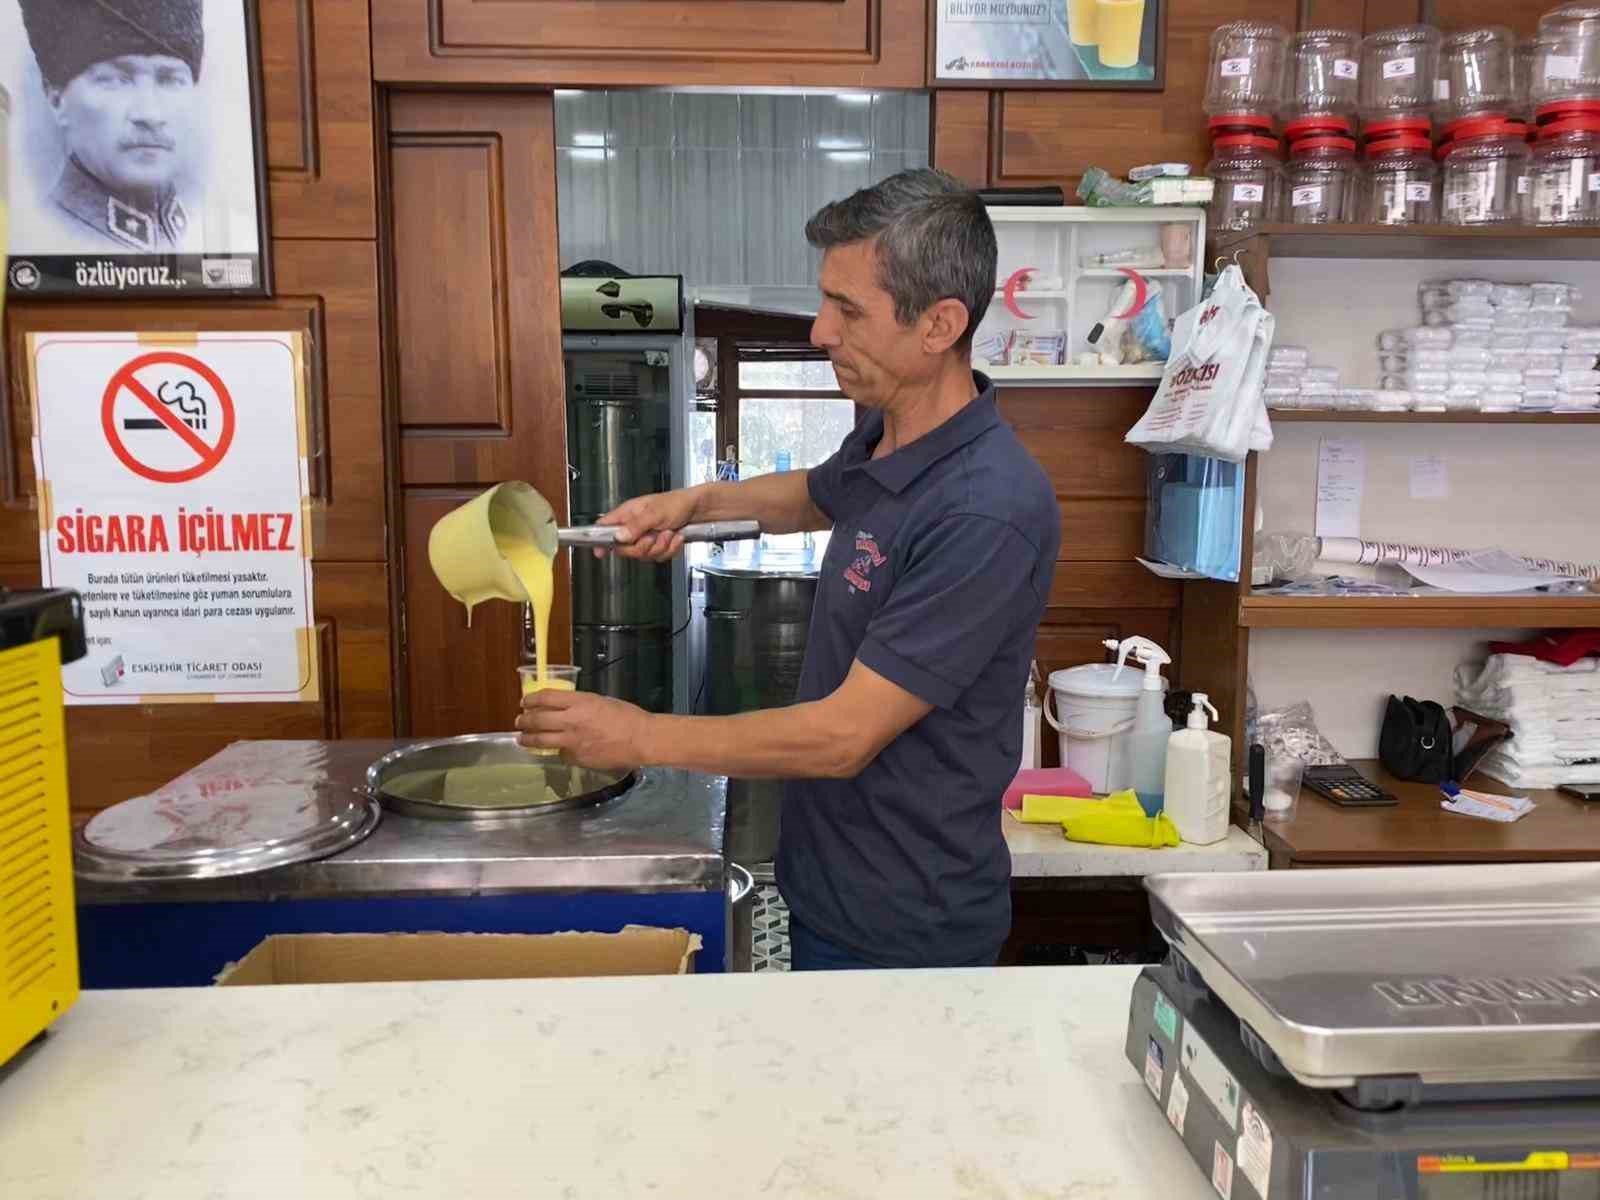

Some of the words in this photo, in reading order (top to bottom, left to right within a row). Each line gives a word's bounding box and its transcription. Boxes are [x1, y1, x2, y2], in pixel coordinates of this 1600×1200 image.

[75, 261, 187, 290] özlüyoruz...
[57, 508, 169, 554] SİGARA
[178, 506, 295, 558] İÇİLMEZ
[88, 573, 119, 584] Burada
[121, 572, 144, 584] tütün
[146, 572, 179, 584] ürünleri
[182, 571, 231, 583] tüketilmesi
[232, 571, 269, 584] yasaktır.
[81, 590, 118, 601] etenlere
[120, 592, 130, 601] ve
[132, 589, 190, 601] tüketilmesine
[210, 590, 239, 601] yuman
[241, 587, 292, 599] sorumlulara
[113, 606, 140, 618] Kanun
[142, 607, 179, 619] uyarınca
[181, 607, 200, 617] idari
[202, 607, 223, 619] para
[225, 606, 253, 616] cezası
[255, 605, 296, 618] uygulanır.
[131, 661, 183, 674] ESKİŞEHİR
[186, 661, 228, 673] TİCARET
[231, 660, 263, 673] ODASI
